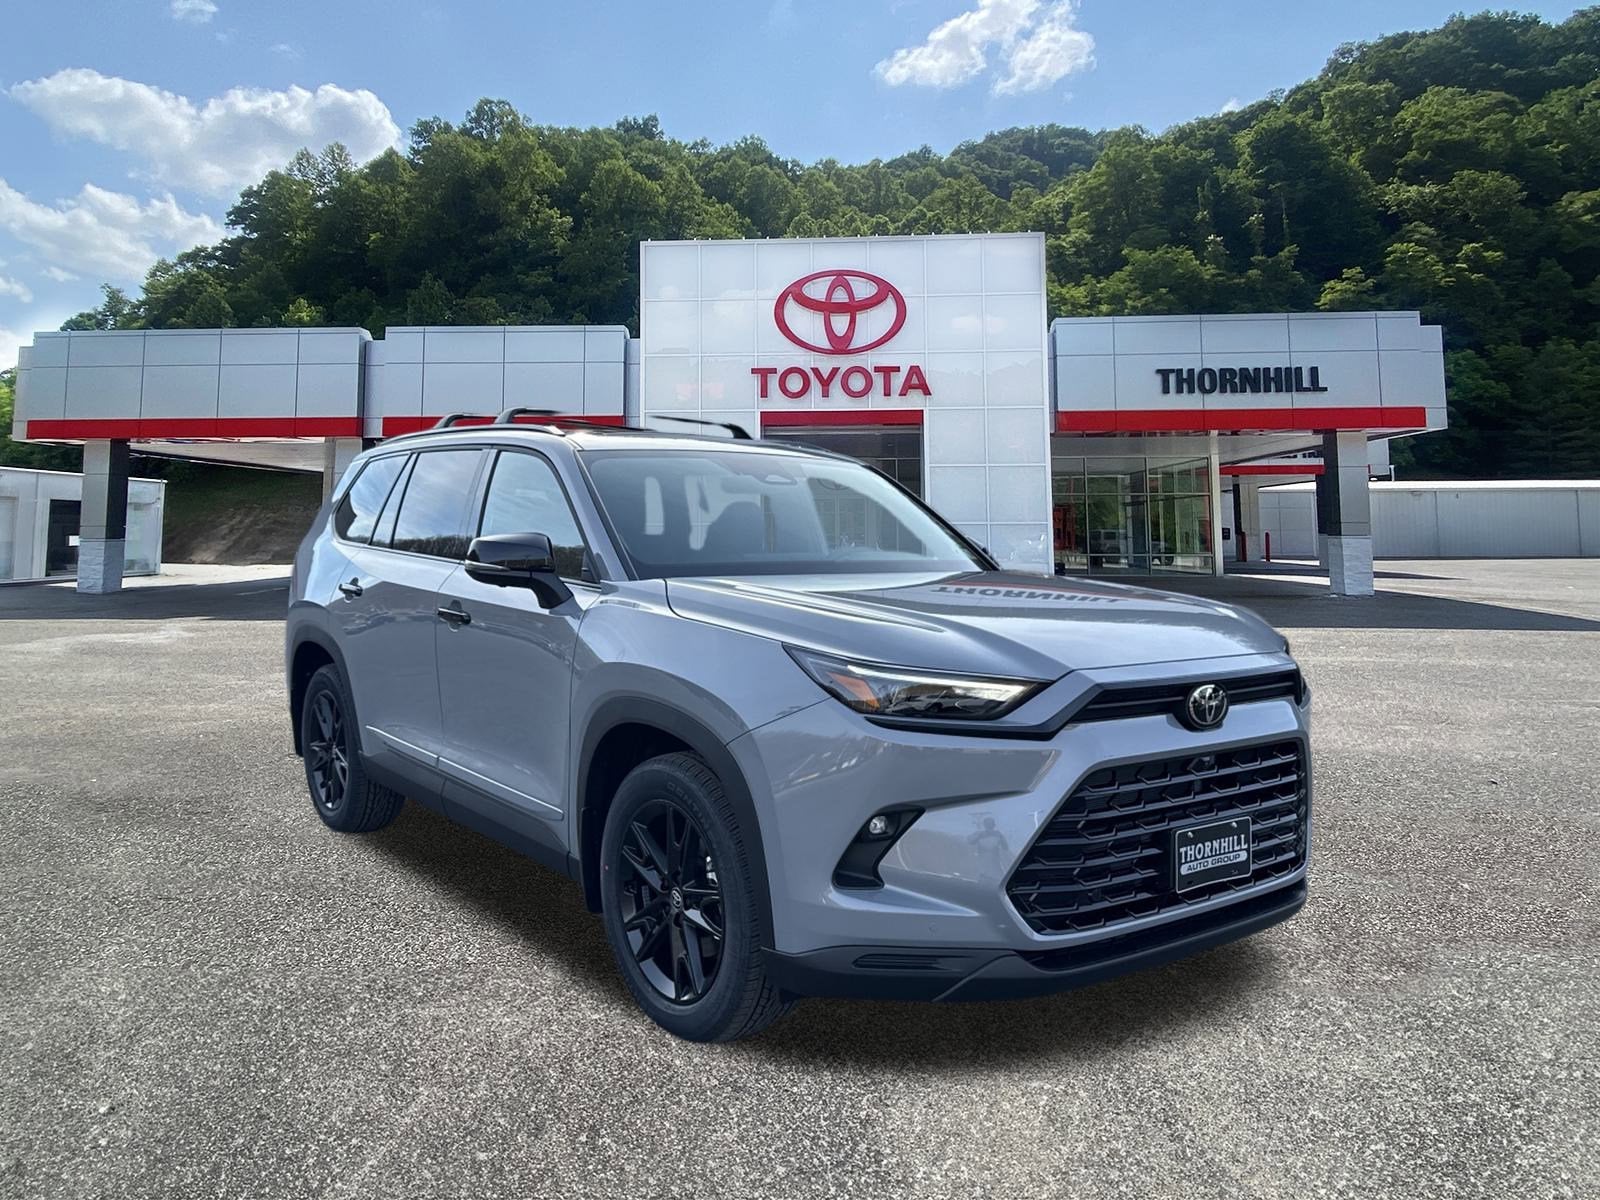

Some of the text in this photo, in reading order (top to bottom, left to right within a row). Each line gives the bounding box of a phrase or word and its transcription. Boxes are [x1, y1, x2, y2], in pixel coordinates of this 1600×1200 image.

[751, 365, 932, 398] TOYOTA
[1155, 366, 1328, 394] THORNHILL
[1180, 834, 1248, 863] THORNHILL
[1186, 853, 1241, 872] AUTO GROUP
